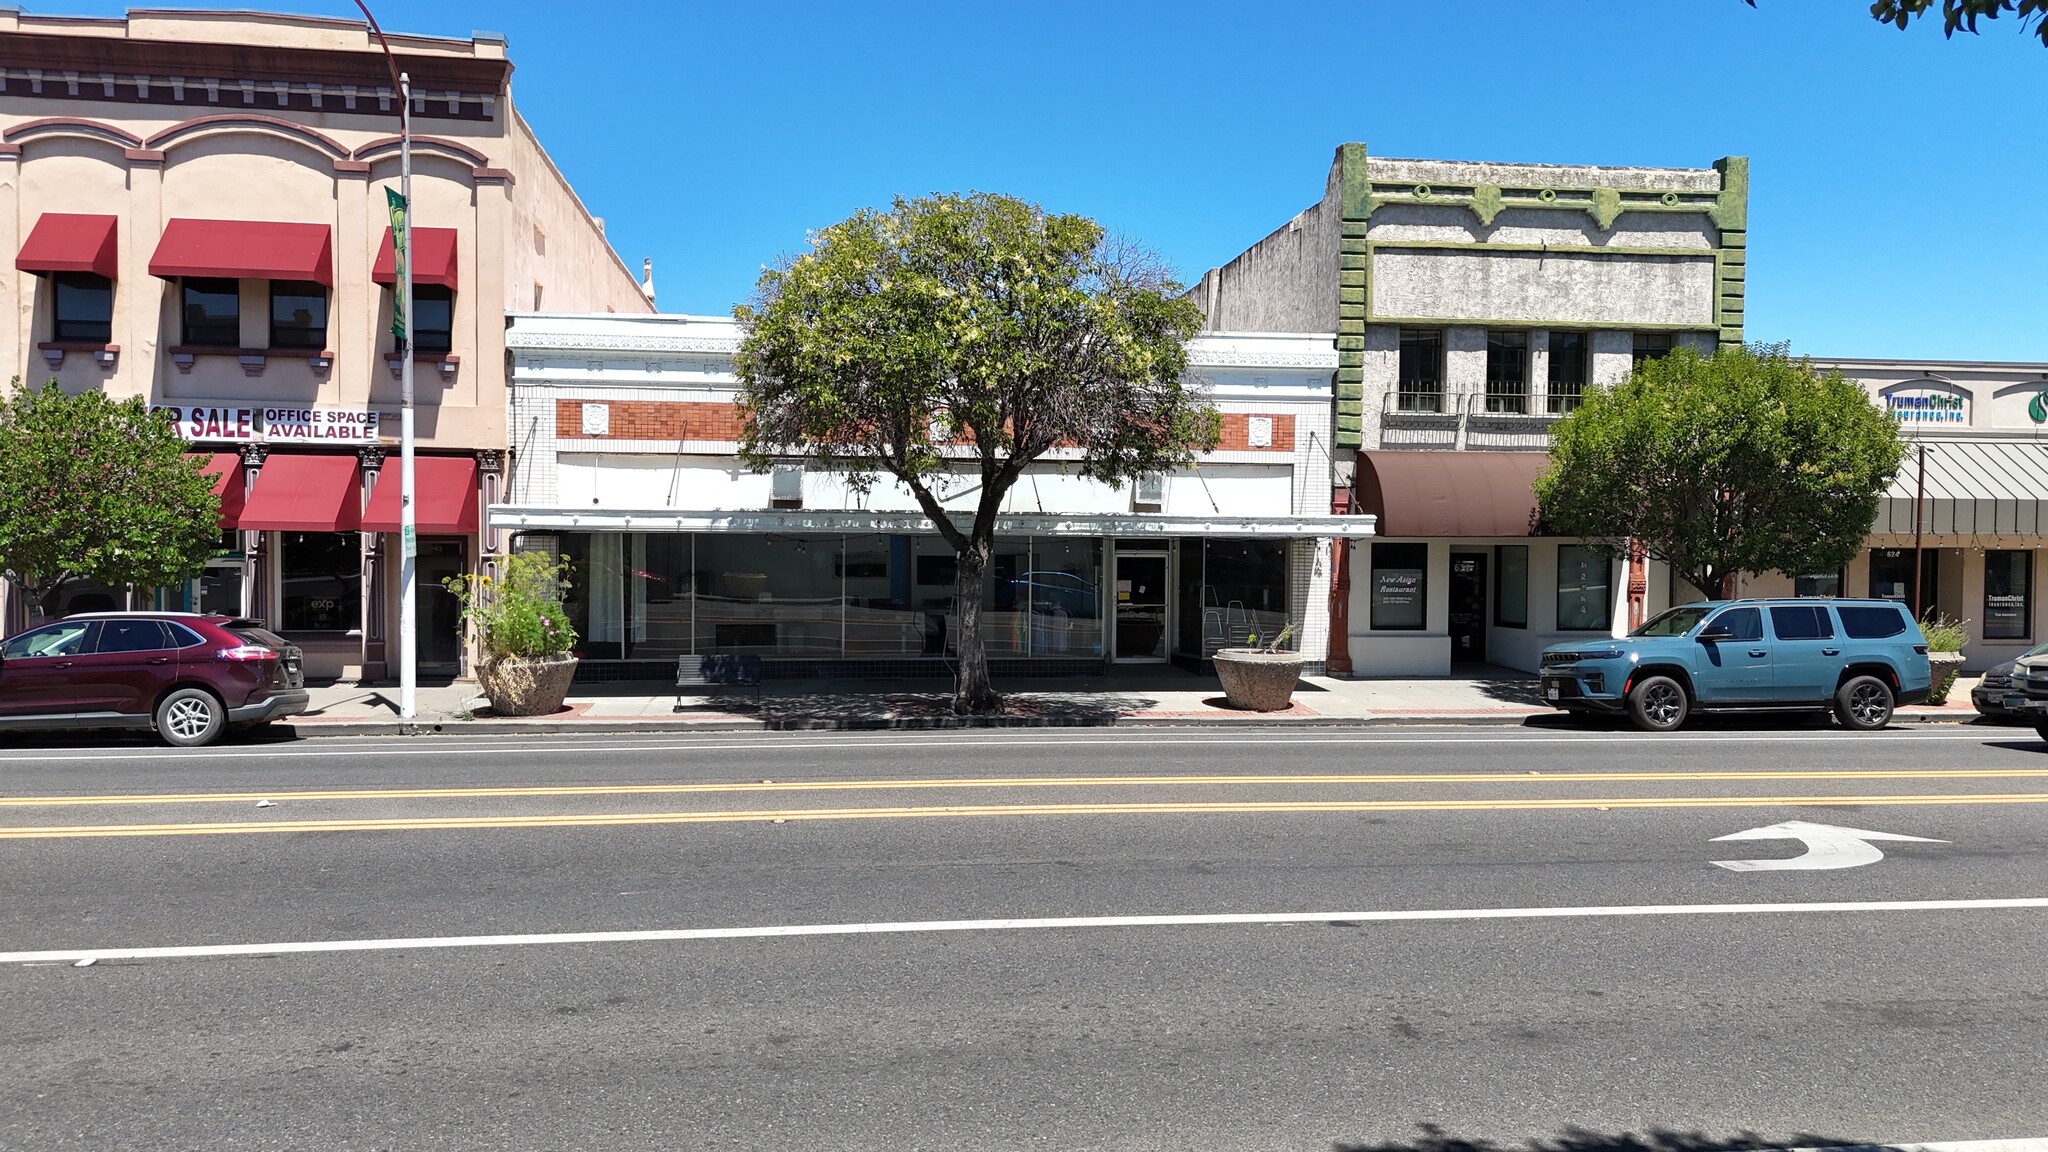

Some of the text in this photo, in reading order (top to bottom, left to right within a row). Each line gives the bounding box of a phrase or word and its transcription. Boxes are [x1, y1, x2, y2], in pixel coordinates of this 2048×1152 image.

[190, 407, 250, 438] SALE
[265, 409, 376, 424] OFFICE SPACE
[268, 424, 374, 439] AVAILABLE
[311, 599, 334, 610] exp
